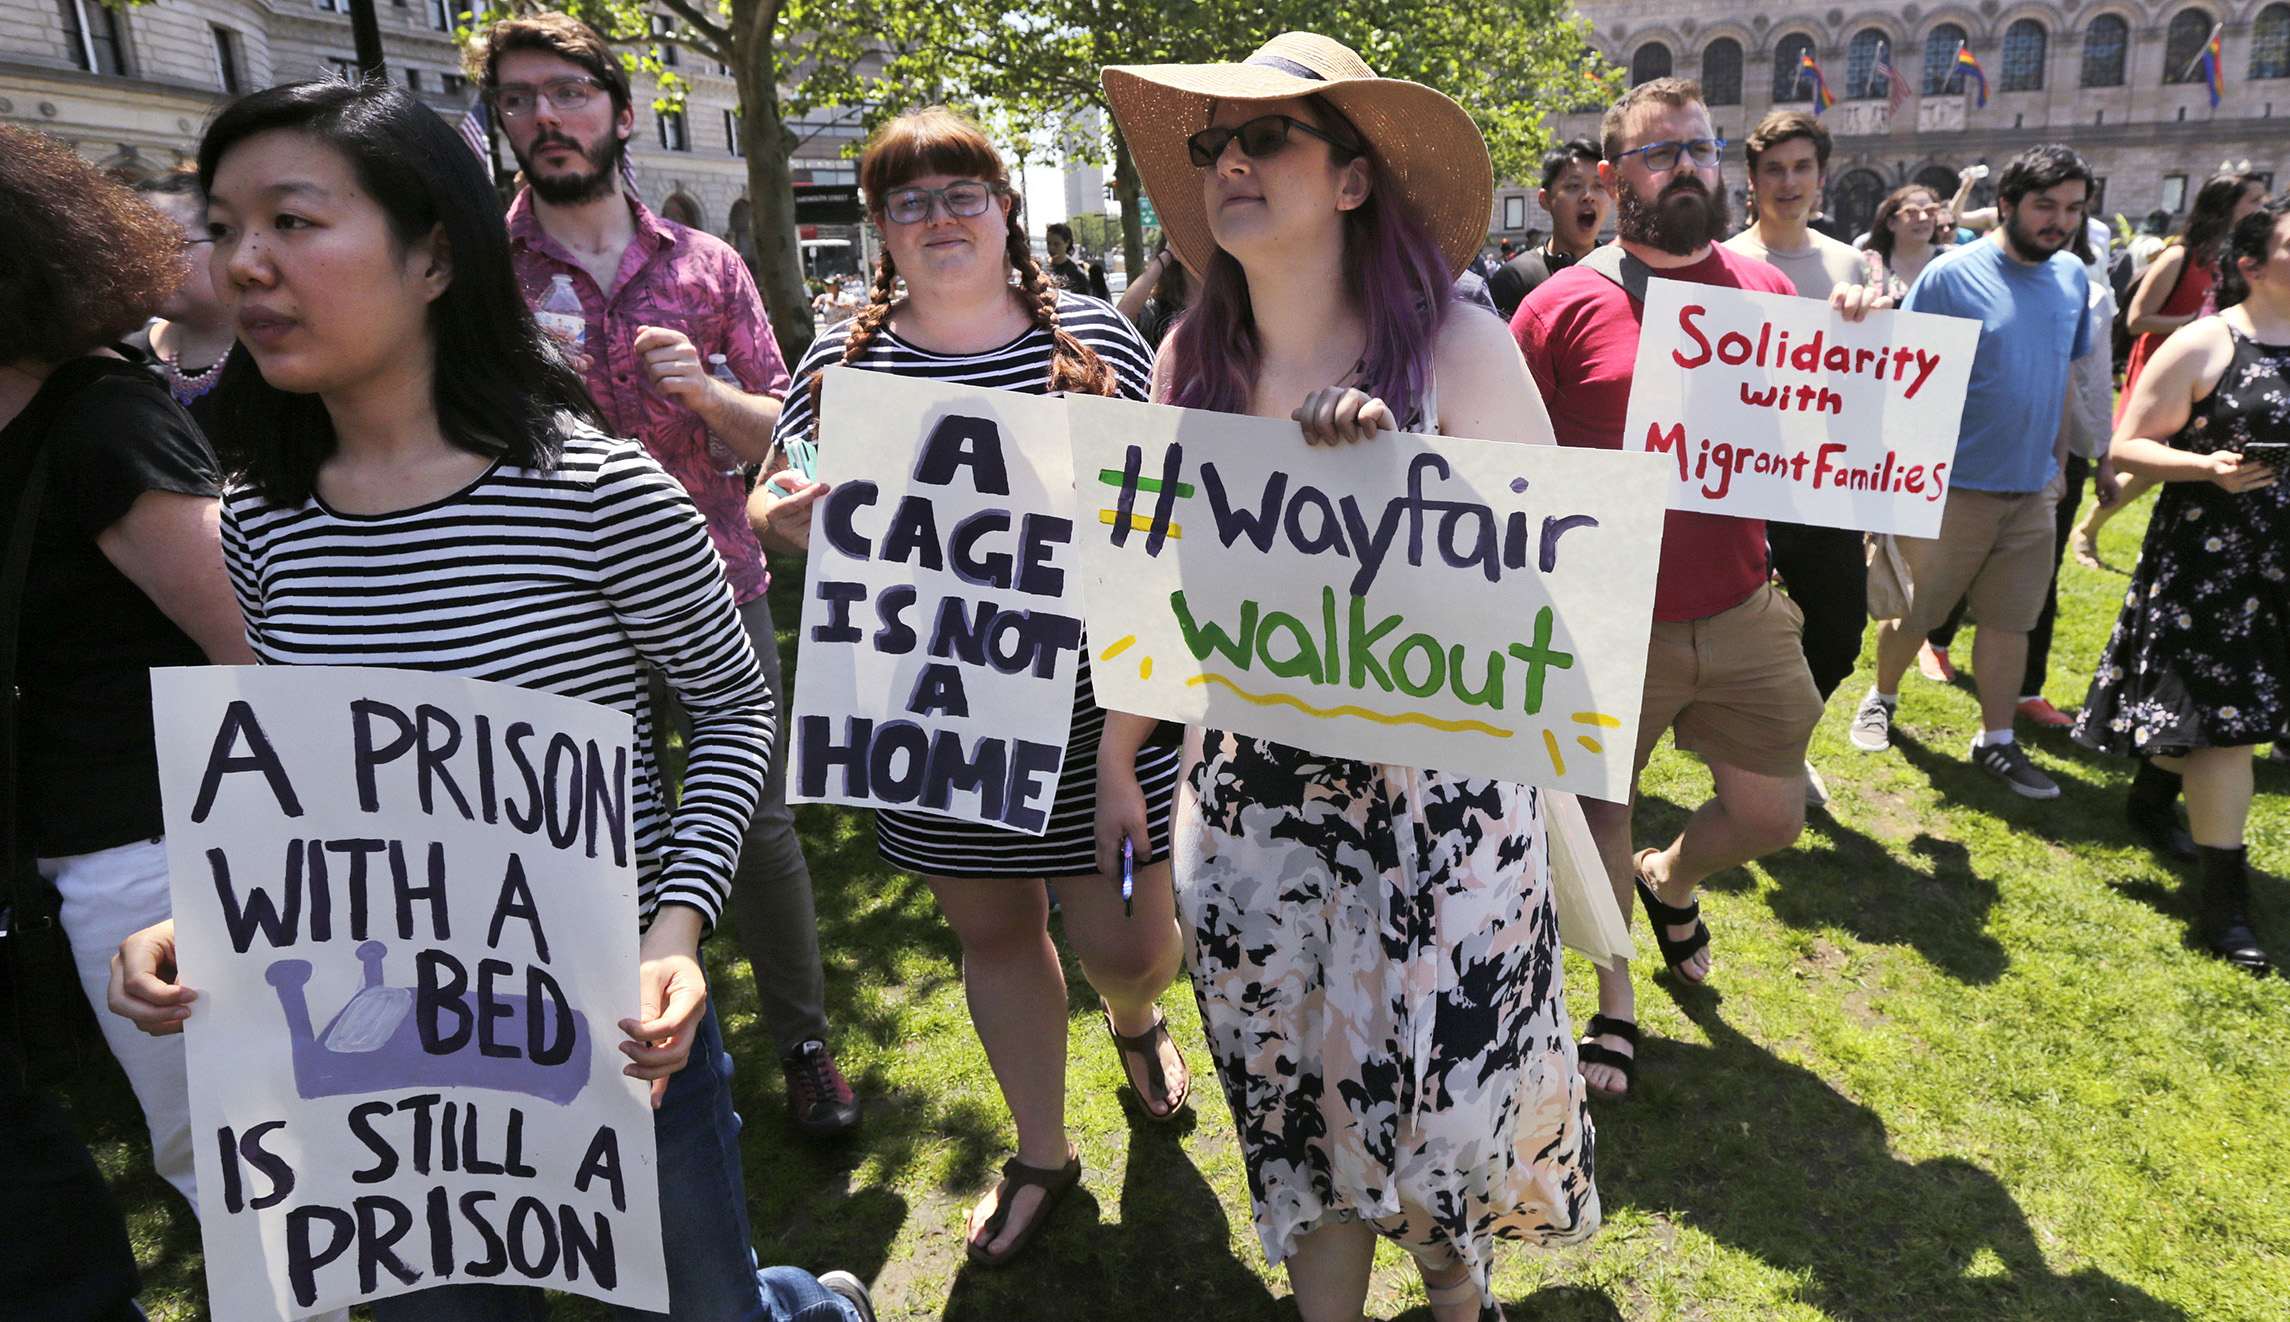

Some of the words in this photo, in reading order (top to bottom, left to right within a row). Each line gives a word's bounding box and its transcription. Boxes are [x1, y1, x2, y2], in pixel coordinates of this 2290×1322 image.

[1672, 305, 1940, 399] Solidarity
[1741, 383, 1842, 414] with
[912, 415, 1009, 496] A
[1645, 422, 1810, 500] Migrant
[1813, 443, 1947, 501] Families
[822, 480, 1073, 598] CAGE
[811, 581, 917, 654] IS
[927, 596, 1082, 679] NOT
[905, 662, 969, 718] A
[191, 700, 304, 823] A
[350, 697, 628, 867] PRISON
[797, 715, 1062, 834] HOME
[206, 838, 450, 954] WITH
[488, 852, 551, 965] A
[416, 948, 577, 1067] BED
[217, 1120, 295, 1214] IS
[348, 1093, 537, 1183] STILL
[574, 1125, 627, 1213] A
[286, 1185, 617, 1308] PRISON
